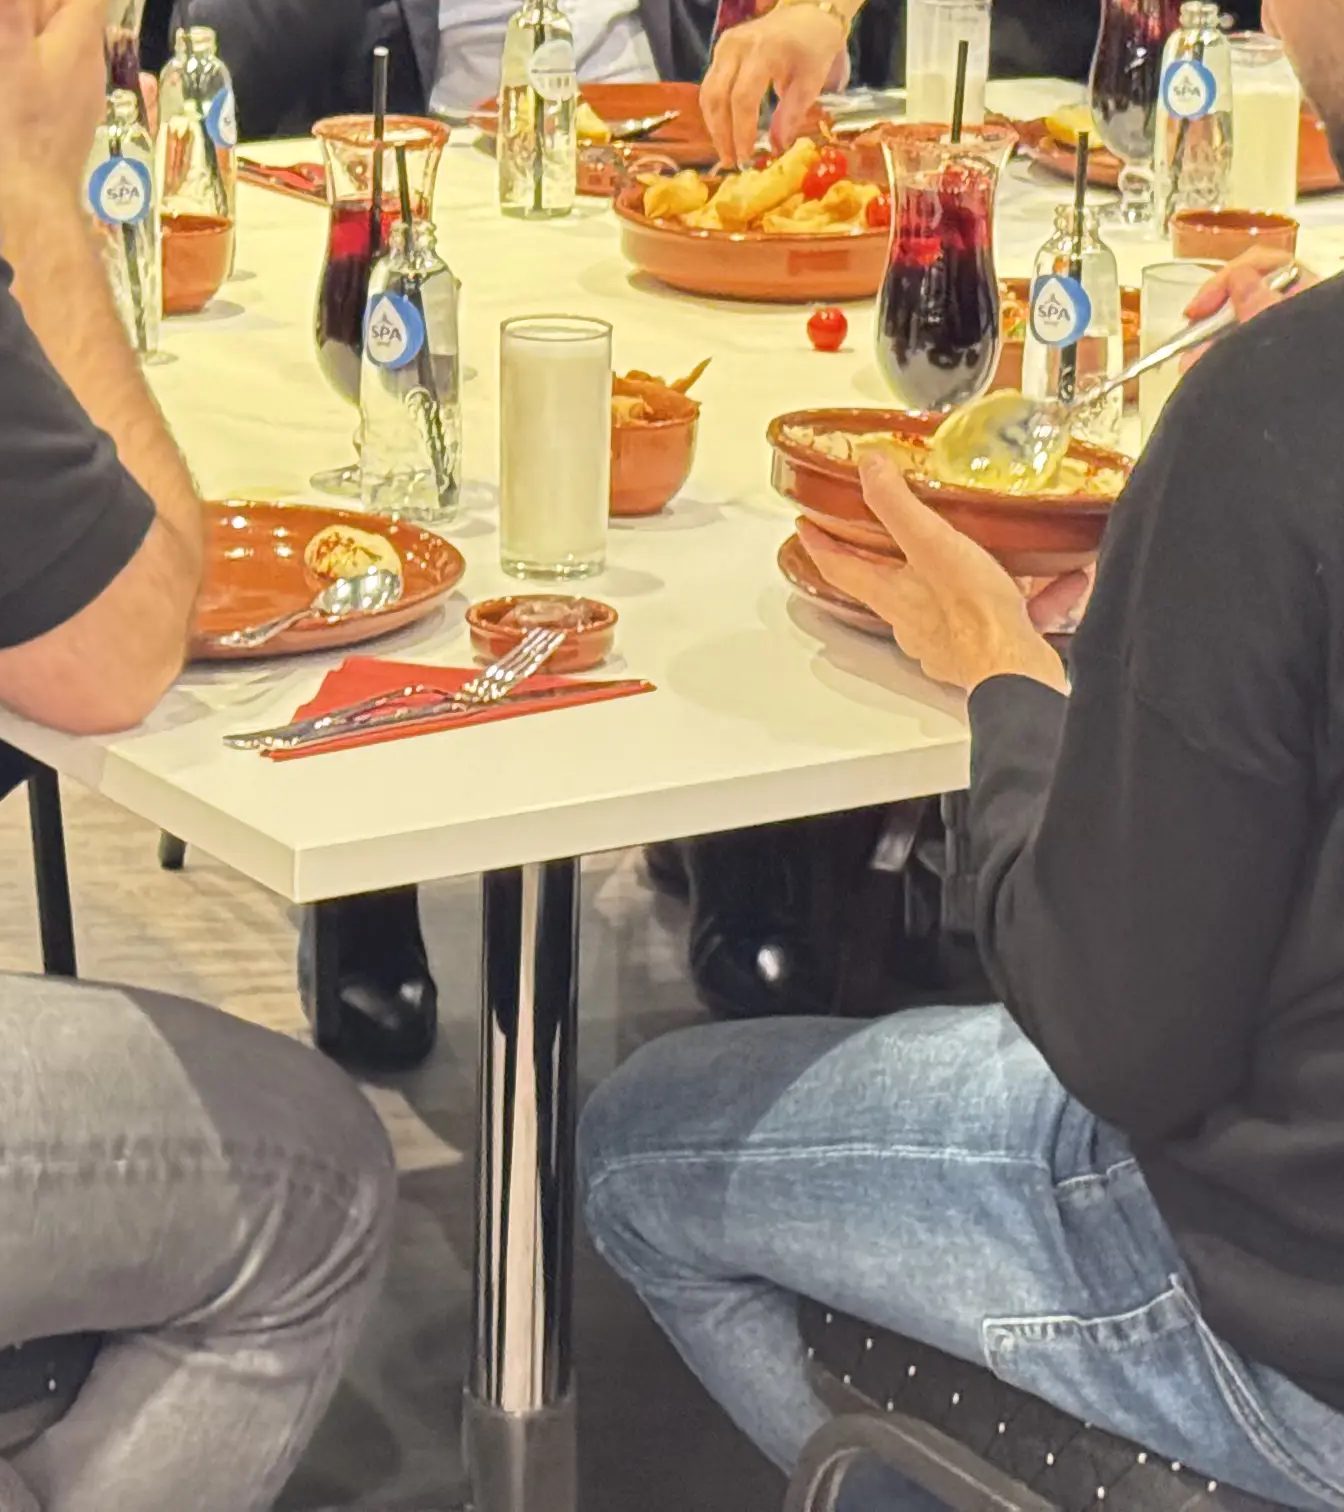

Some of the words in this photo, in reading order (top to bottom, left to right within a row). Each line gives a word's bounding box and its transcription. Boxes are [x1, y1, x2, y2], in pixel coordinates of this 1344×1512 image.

[1173, 85, 1201, 97] SPA
[107, 187, 140, 199] SPA
[1038, 304, 1071, 321] SPA
[371, 324, 403, 342] SPA
